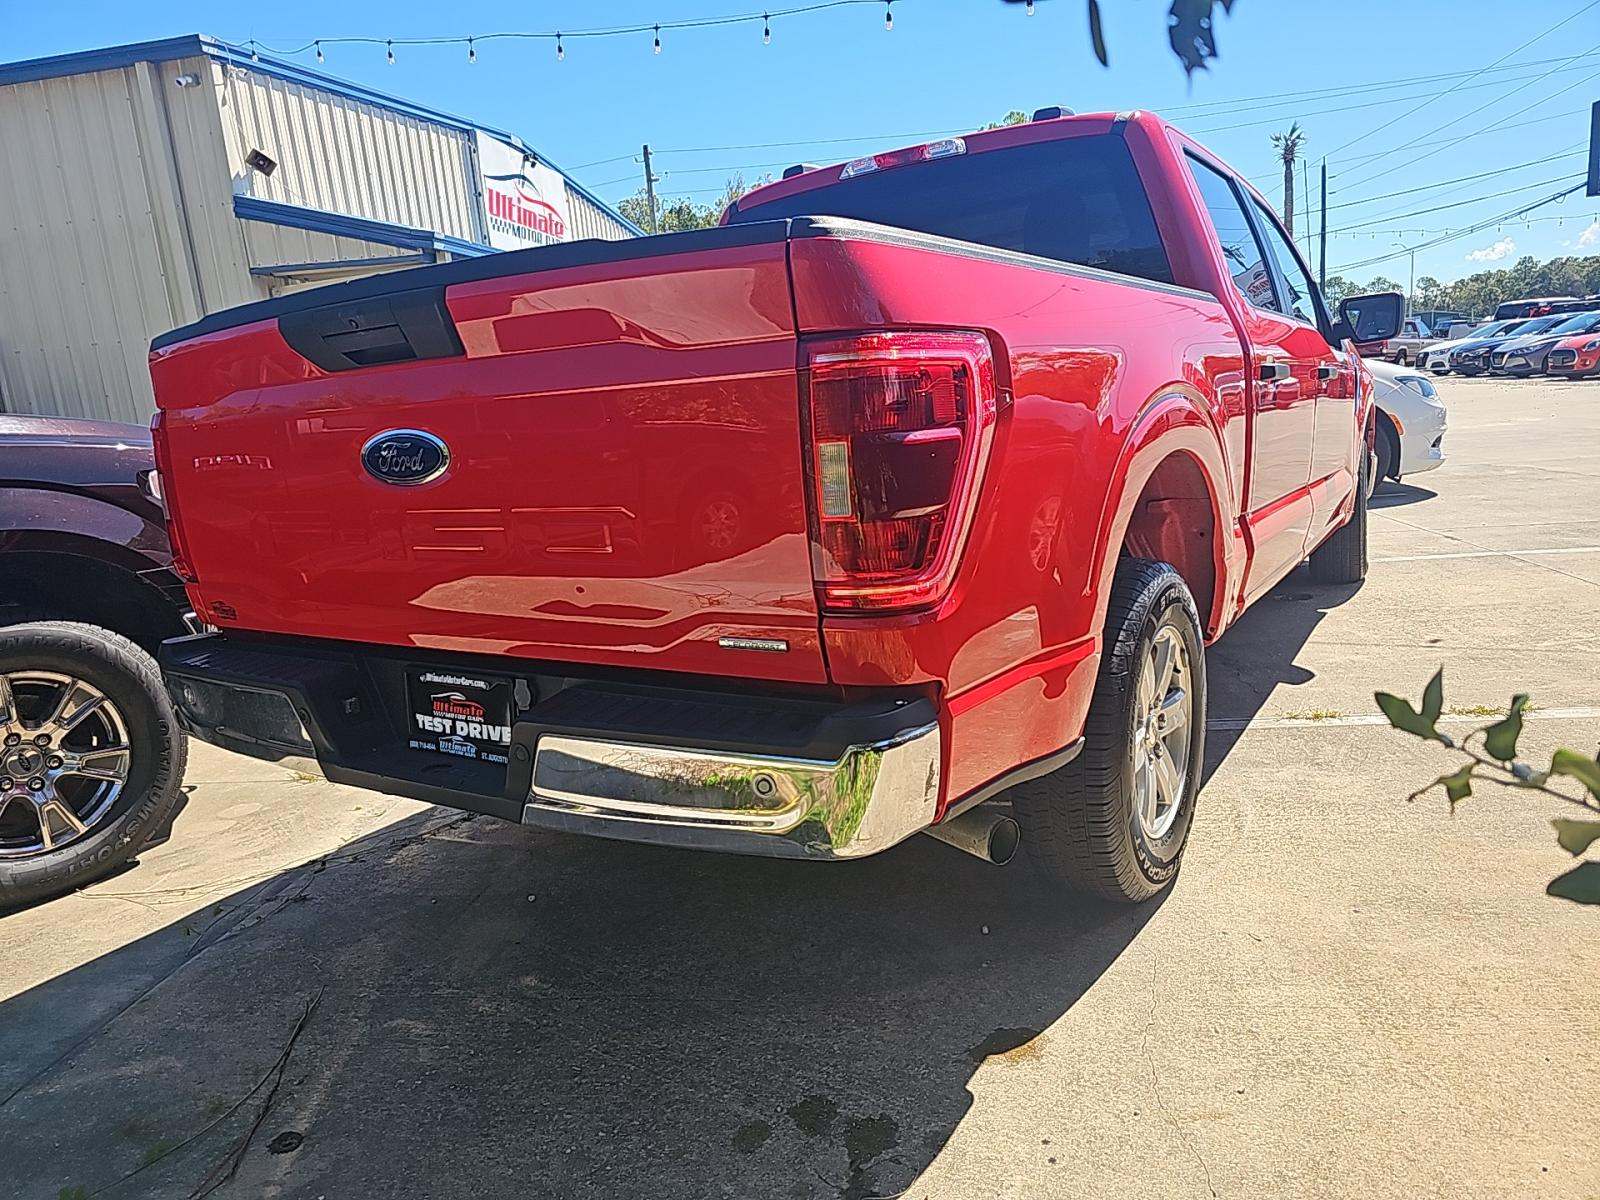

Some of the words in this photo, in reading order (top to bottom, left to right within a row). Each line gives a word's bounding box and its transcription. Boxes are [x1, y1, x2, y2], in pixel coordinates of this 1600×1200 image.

[488, 187, 565, 239] Ultimate
[511, 223, 543, 245] MOTOR
[379, 441, 424, 473] Ford
[433, 700, 484, 717] Ultimate
[415, 712, 453, 735] TEST
[455, 721, 512, 742] DRIVE
